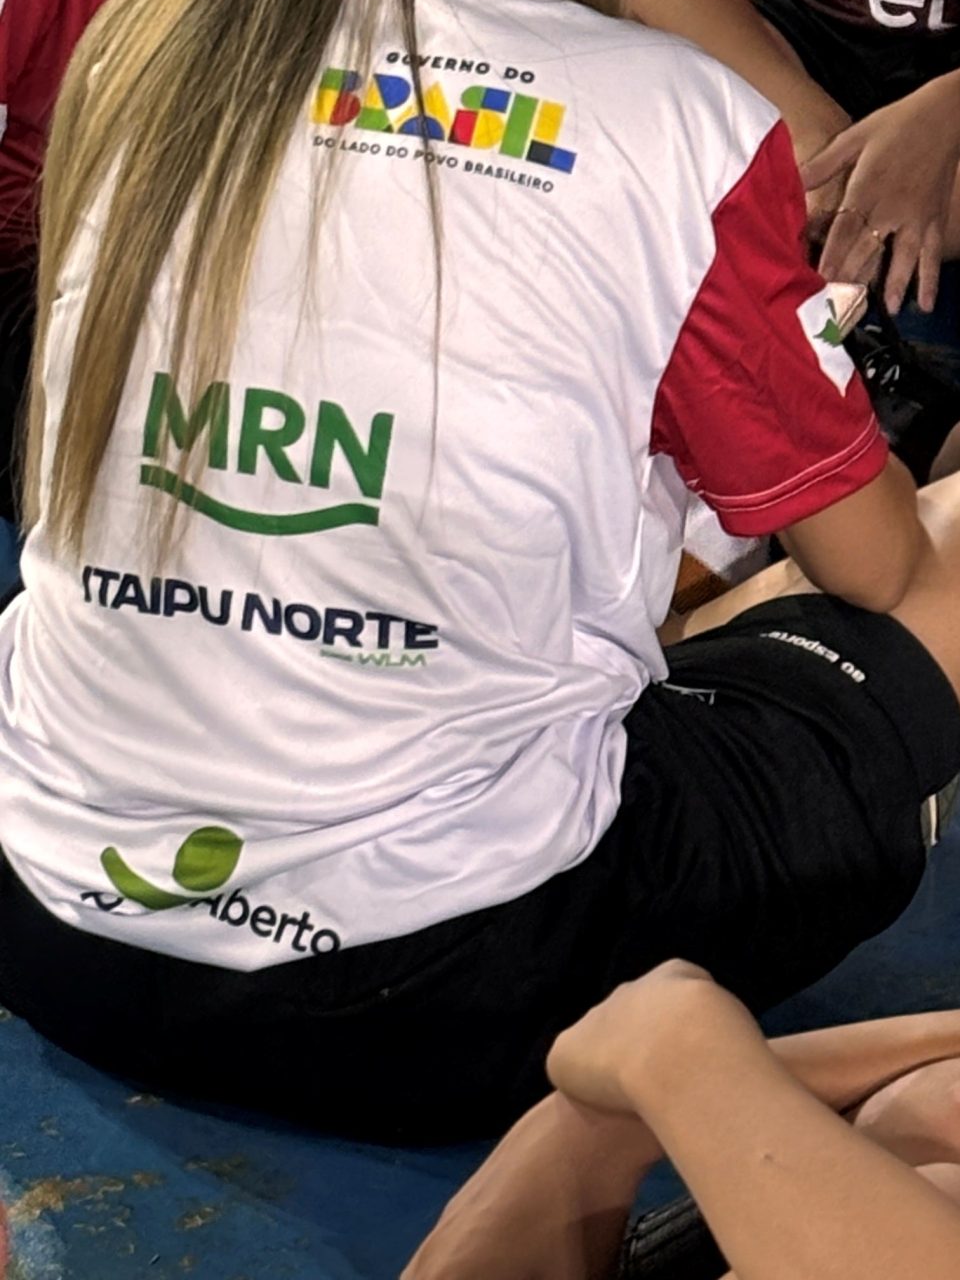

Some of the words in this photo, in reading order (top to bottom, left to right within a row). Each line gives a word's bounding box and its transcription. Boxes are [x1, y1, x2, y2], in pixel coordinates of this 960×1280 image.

[386, 51, 490, 75] GOVERNO
[503, 66, 536, 84] DO
[310, 66, 577, 175] BRASIL
[312, 135, 336, 149] DO
[340, 139, 381, 155] LADO
[385, 144, 408, 158] DO
[413, 149, 458, 168] POVO
[463, 160, 554, 193] BRASILEIRO
[142, 371, 395, 500] MRN
[241, 592, 439, 650] NORTE
